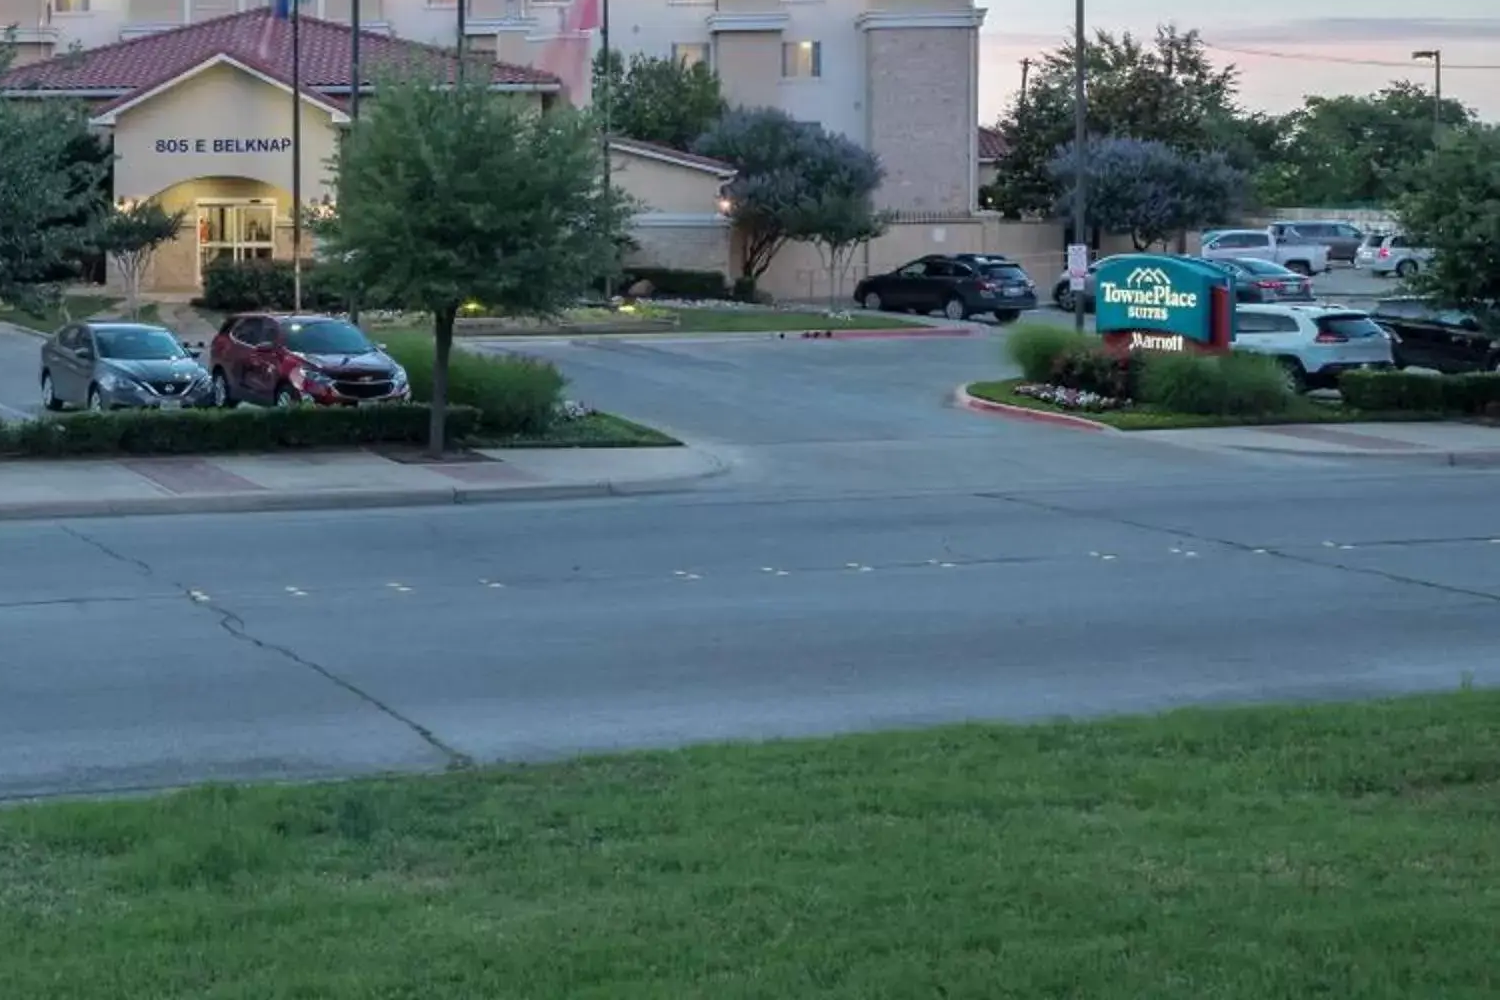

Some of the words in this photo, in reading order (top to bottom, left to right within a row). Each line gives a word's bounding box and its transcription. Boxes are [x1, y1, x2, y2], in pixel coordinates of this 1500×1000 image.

[155, 138, 189, 153] 805
[195, 138, 207, 153] E
[212, 137, 292, 153] BELKNAP
[1101, 281, 1198, 308] TownePlace
[1127, 305, 1169, 321] SUITES
[1129, 331, 1184, 351] Marriott
